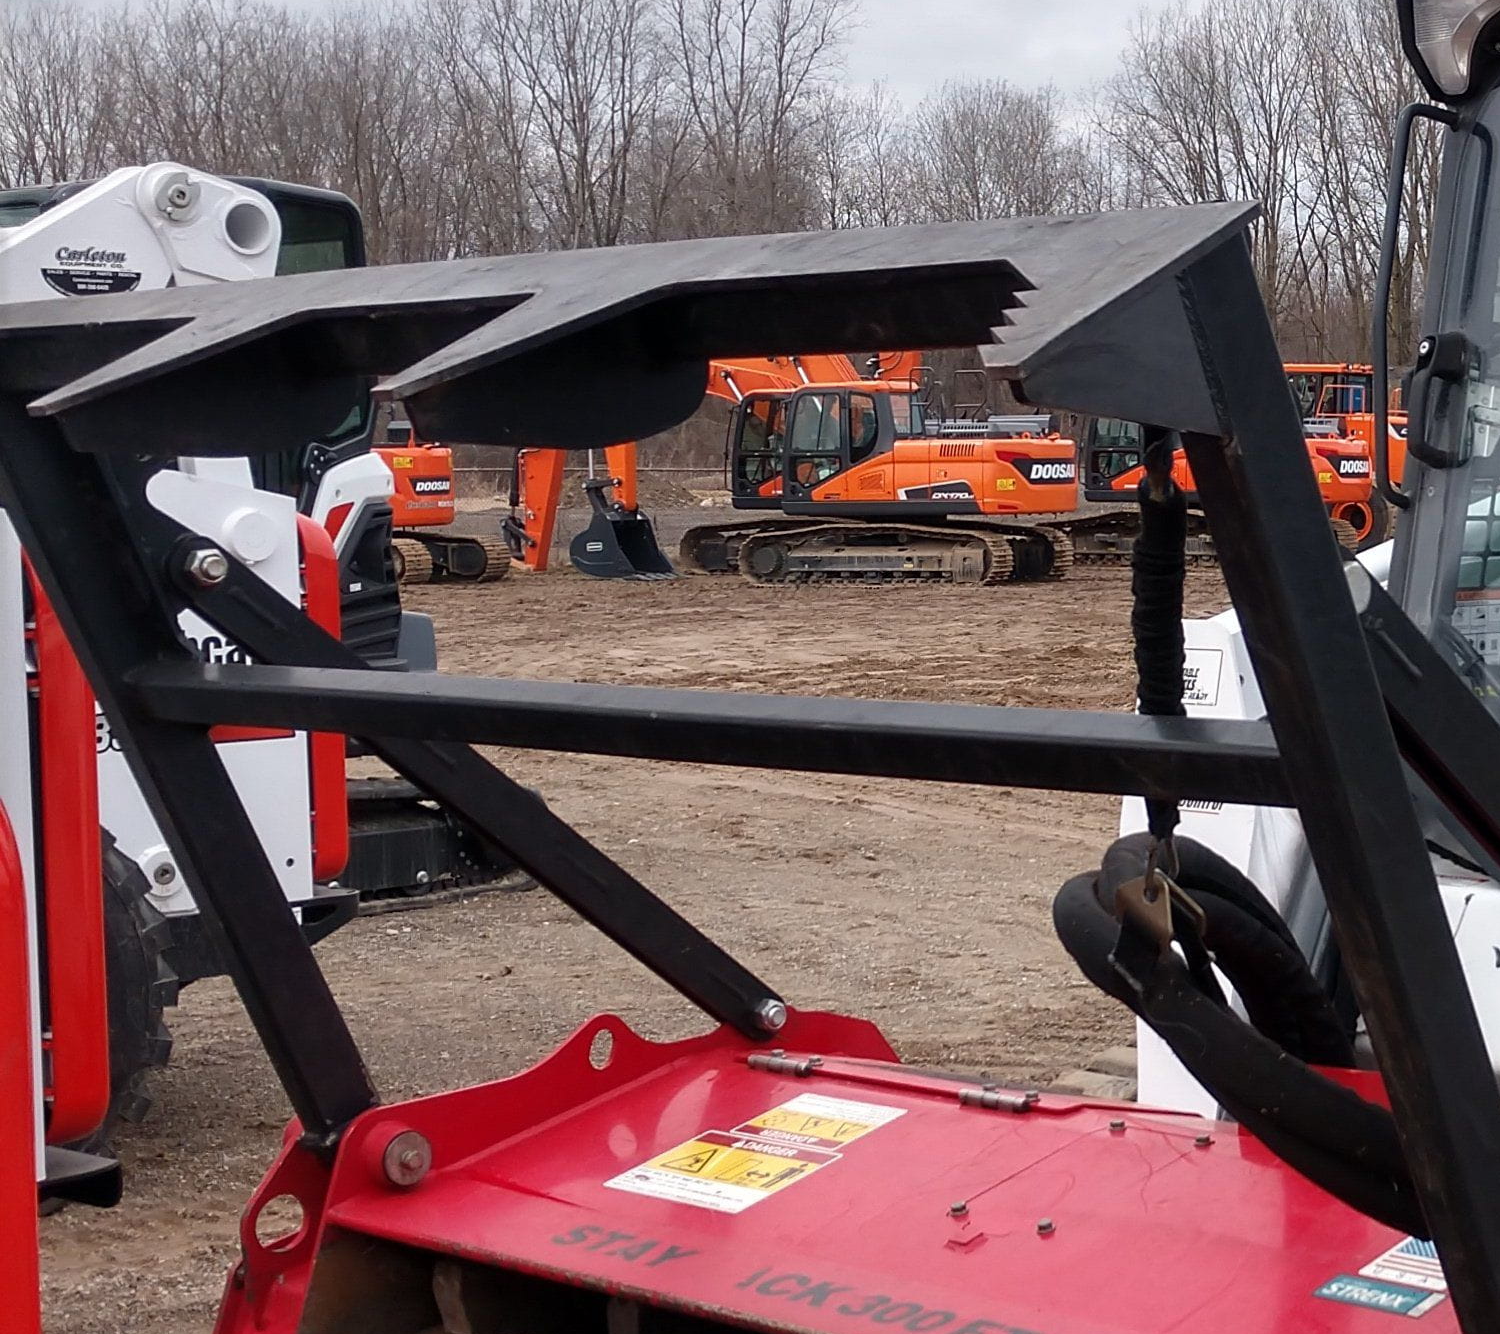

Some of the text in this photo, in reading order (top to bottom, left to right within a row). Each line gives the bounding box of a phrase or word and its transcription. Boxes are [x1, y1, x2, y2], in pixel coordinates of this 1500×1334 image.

[55, 246, 127, 264] Carleton
[743, 1141, 799, 1157] DANGER
[552, 1224, 699, 1268] STAY
